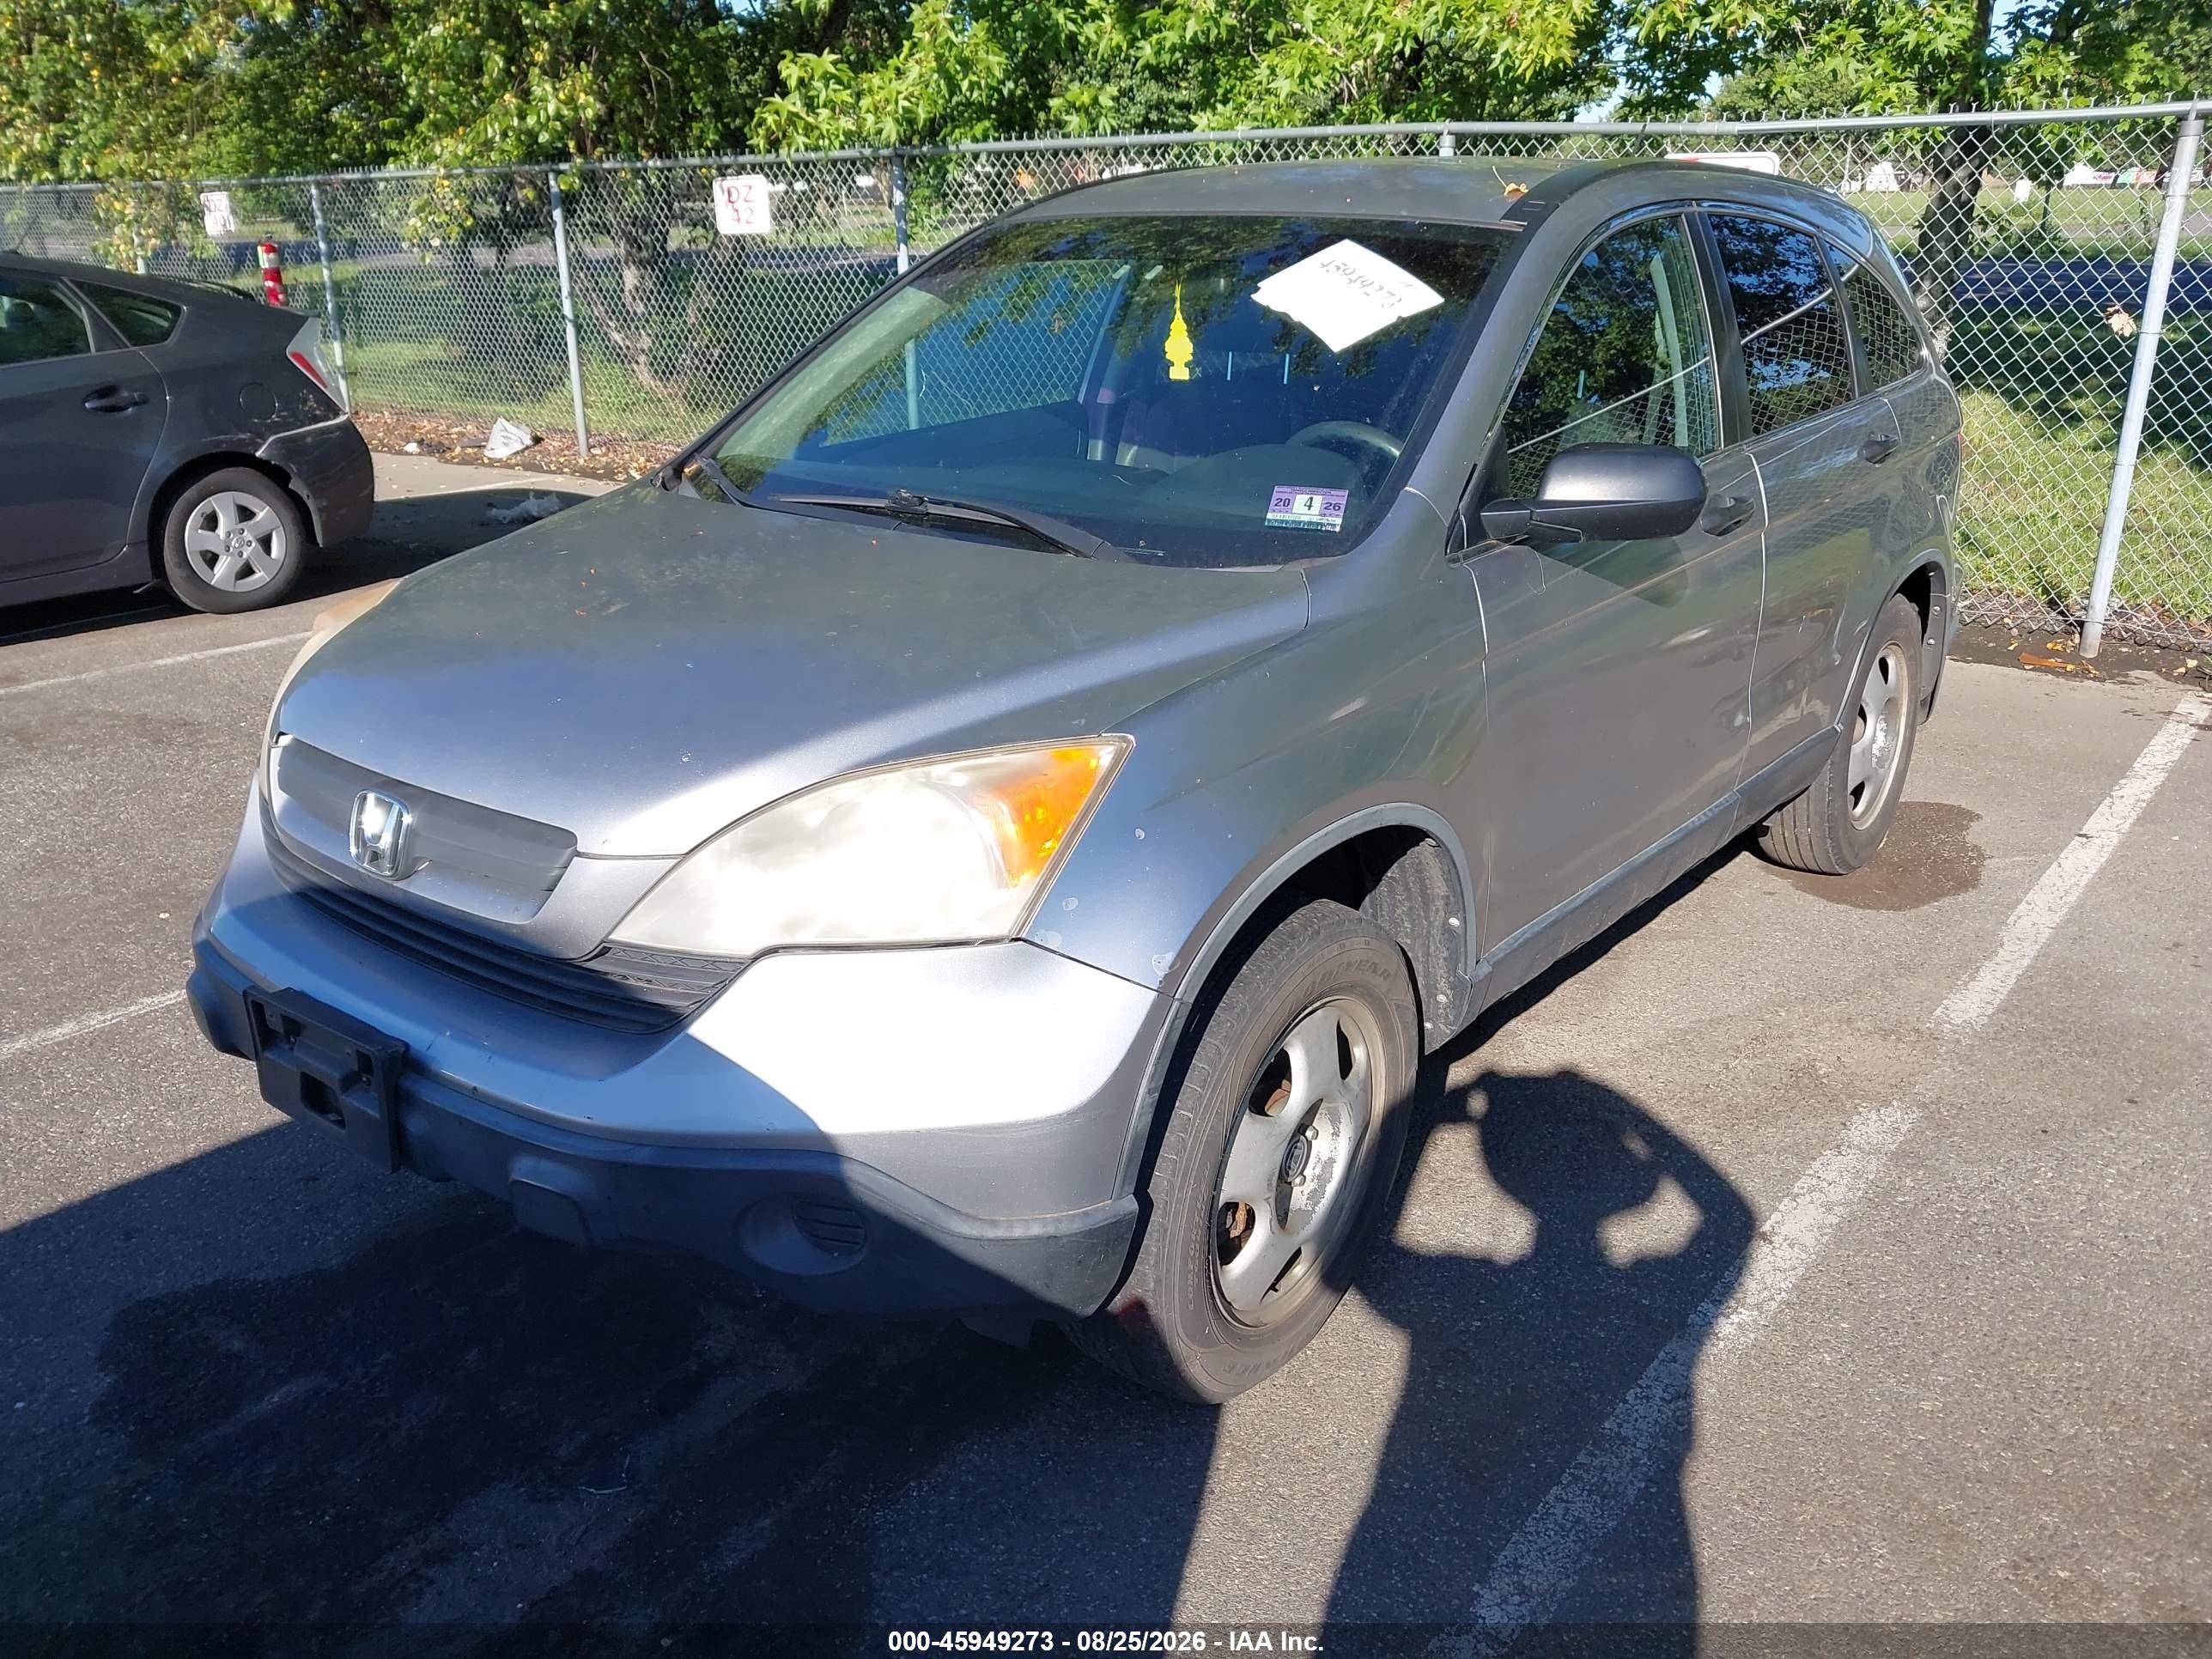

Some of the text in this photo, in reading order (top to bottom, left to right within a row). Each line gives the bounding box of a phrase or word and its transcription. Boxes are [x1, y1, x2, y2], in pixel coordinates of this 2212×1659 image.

[727, 185, 755, 204] DZ
[1273, 495, 1342, 512] 20 4 26
